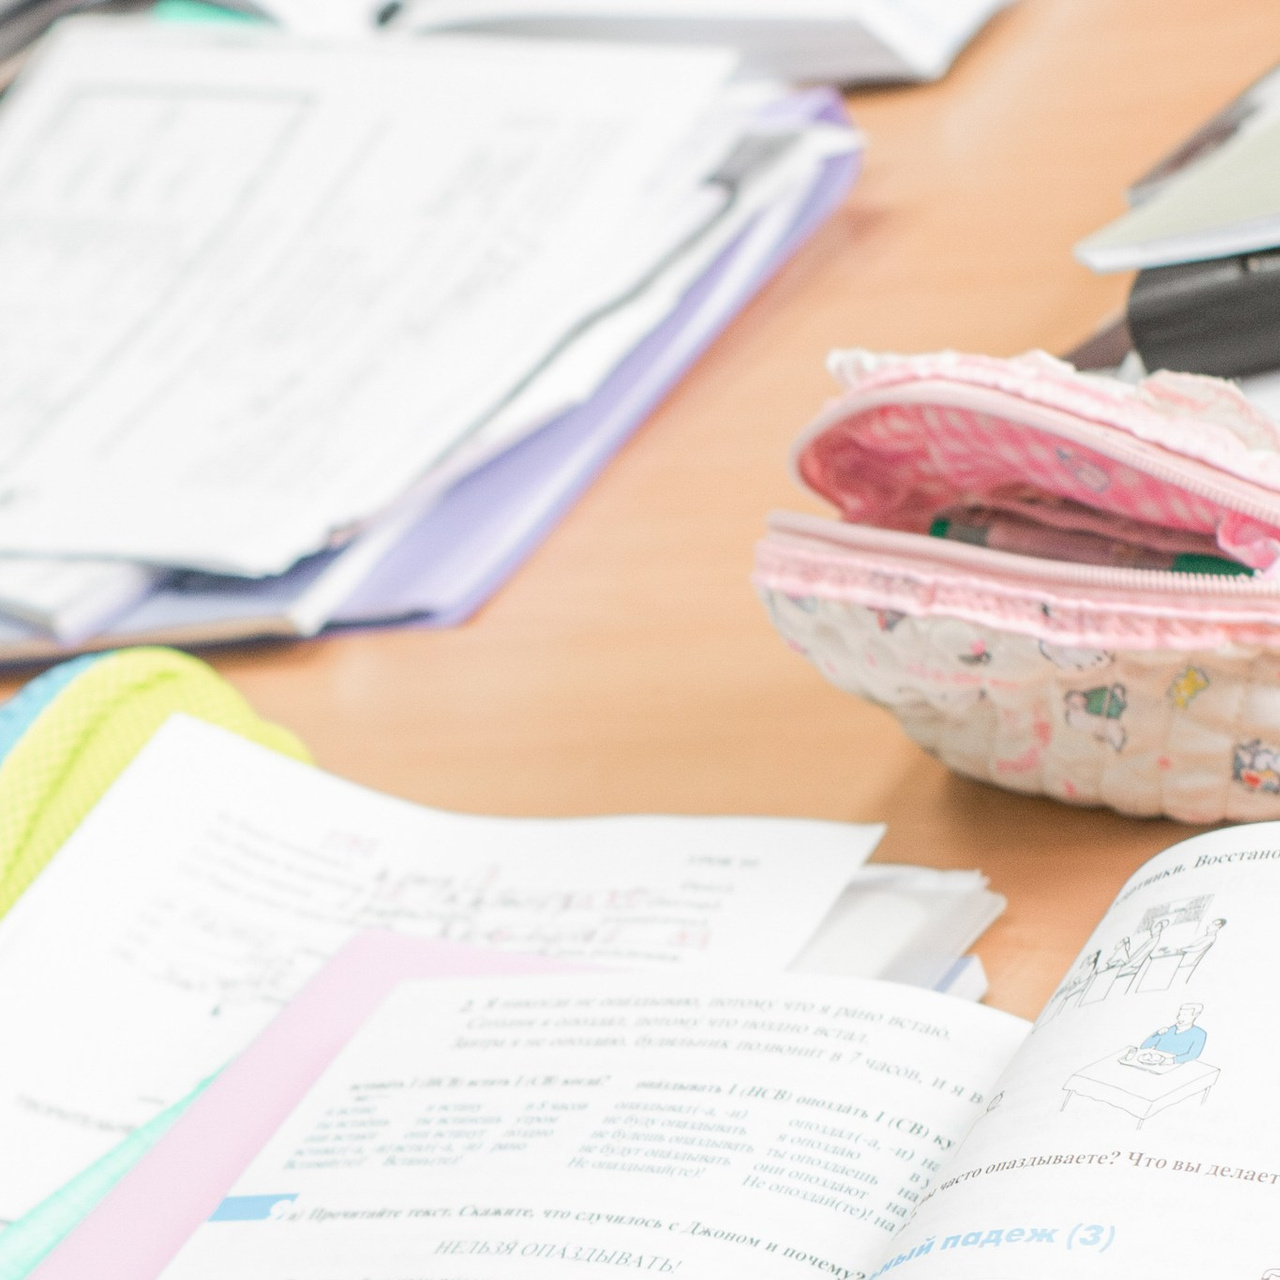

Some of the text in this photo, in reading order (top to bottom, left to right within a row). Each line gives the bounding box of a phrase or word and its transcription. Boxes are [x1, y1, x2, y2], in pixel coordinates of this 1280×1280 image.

[985, 1150, 1120, 1175] опаздываете?
[1125, 1150, 1168, 1172] Что
[1172, 1159, 1201, 1175] вы
[458, 1205, 534, 1218] Скажите,
[543, 1209, 571, 1219] что
[574, 1212, 662, 1228] случилось
[668, 1222, 679, 1231] с
[682, 1221, 761, 1247] Джоном
[765, 1242, 778, 1252] и
[939, 1225, 1060, 1251] падеж
[1066, 1222, 1116, 1253] (3)
